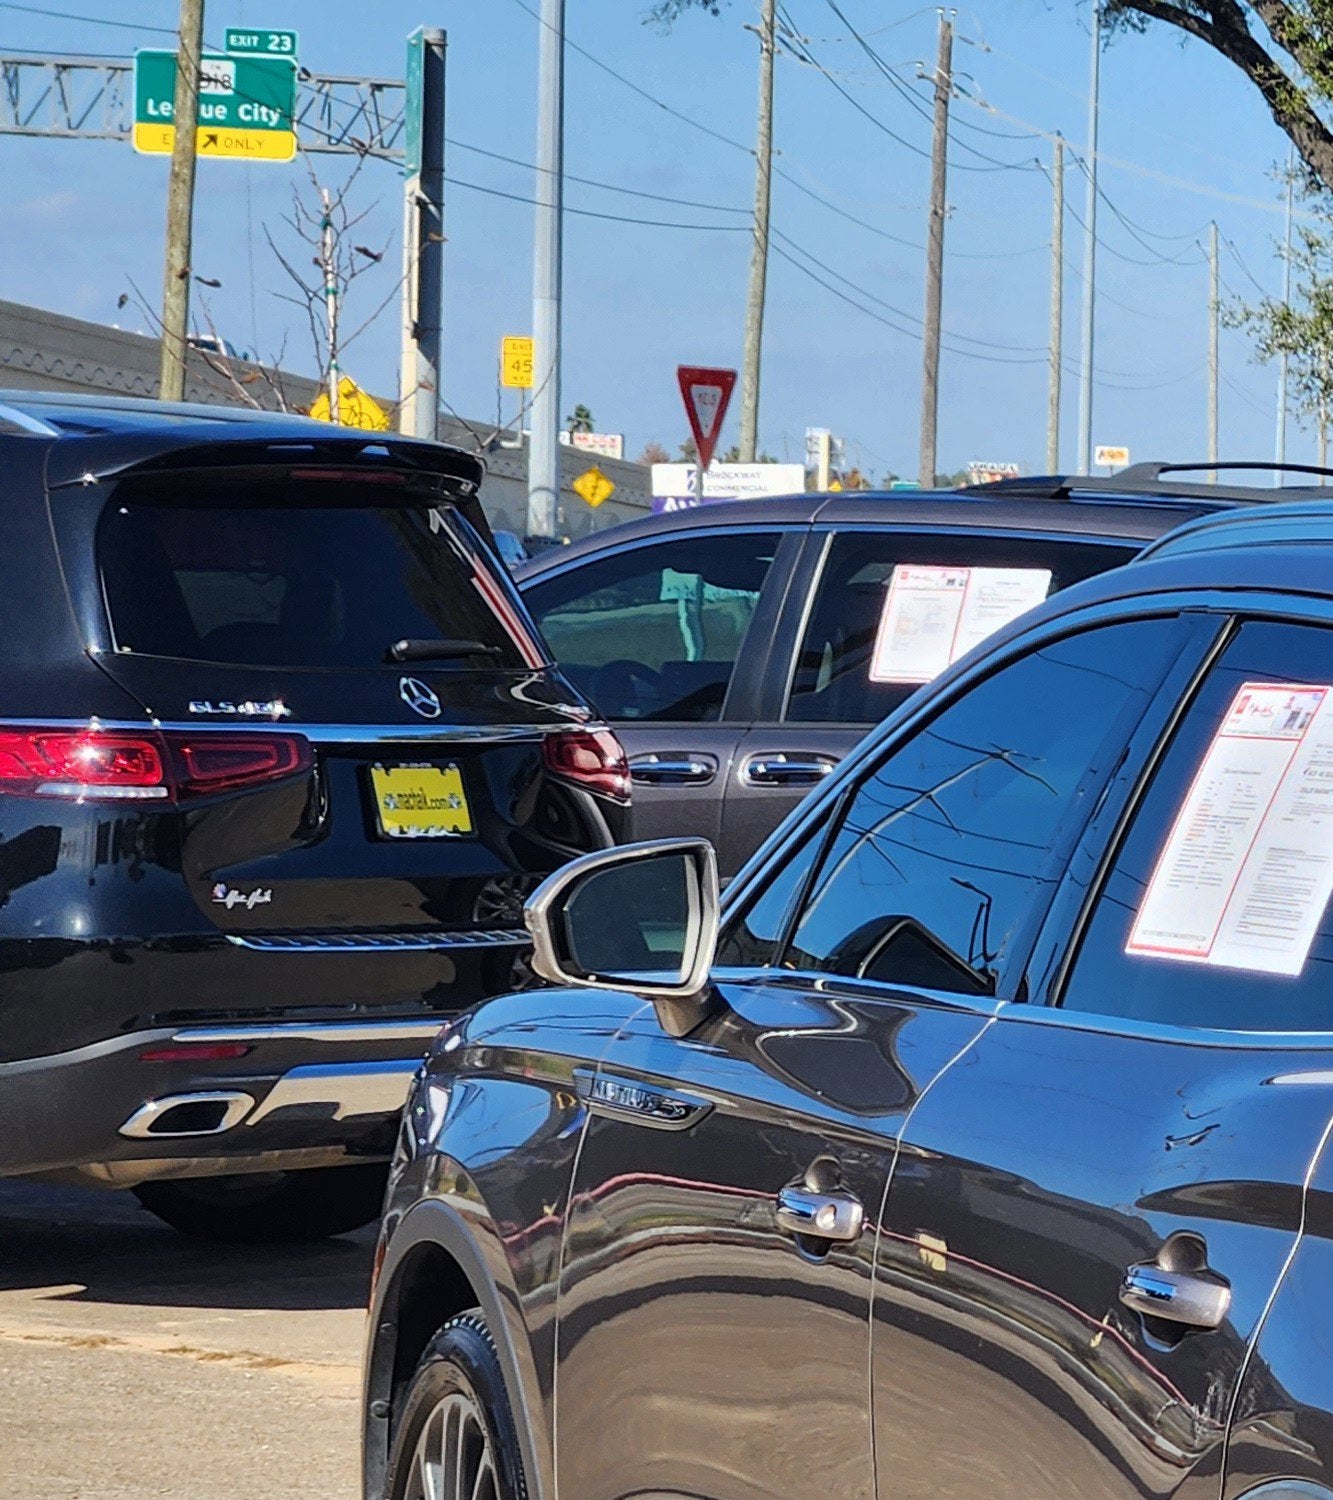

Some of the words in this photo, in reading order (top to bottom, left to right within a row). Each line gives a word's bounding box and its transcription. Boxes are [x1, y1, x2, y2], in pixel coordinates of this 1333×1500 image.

[229, 35, 259, 47] EXIT
[267, 35, 292, 51] 23
[147, 98, 228, 120] Leue
[237, 102, 281, 127] City
[224, 137, 266, 151] ONLY
[511, 359, 533, 373] 45
